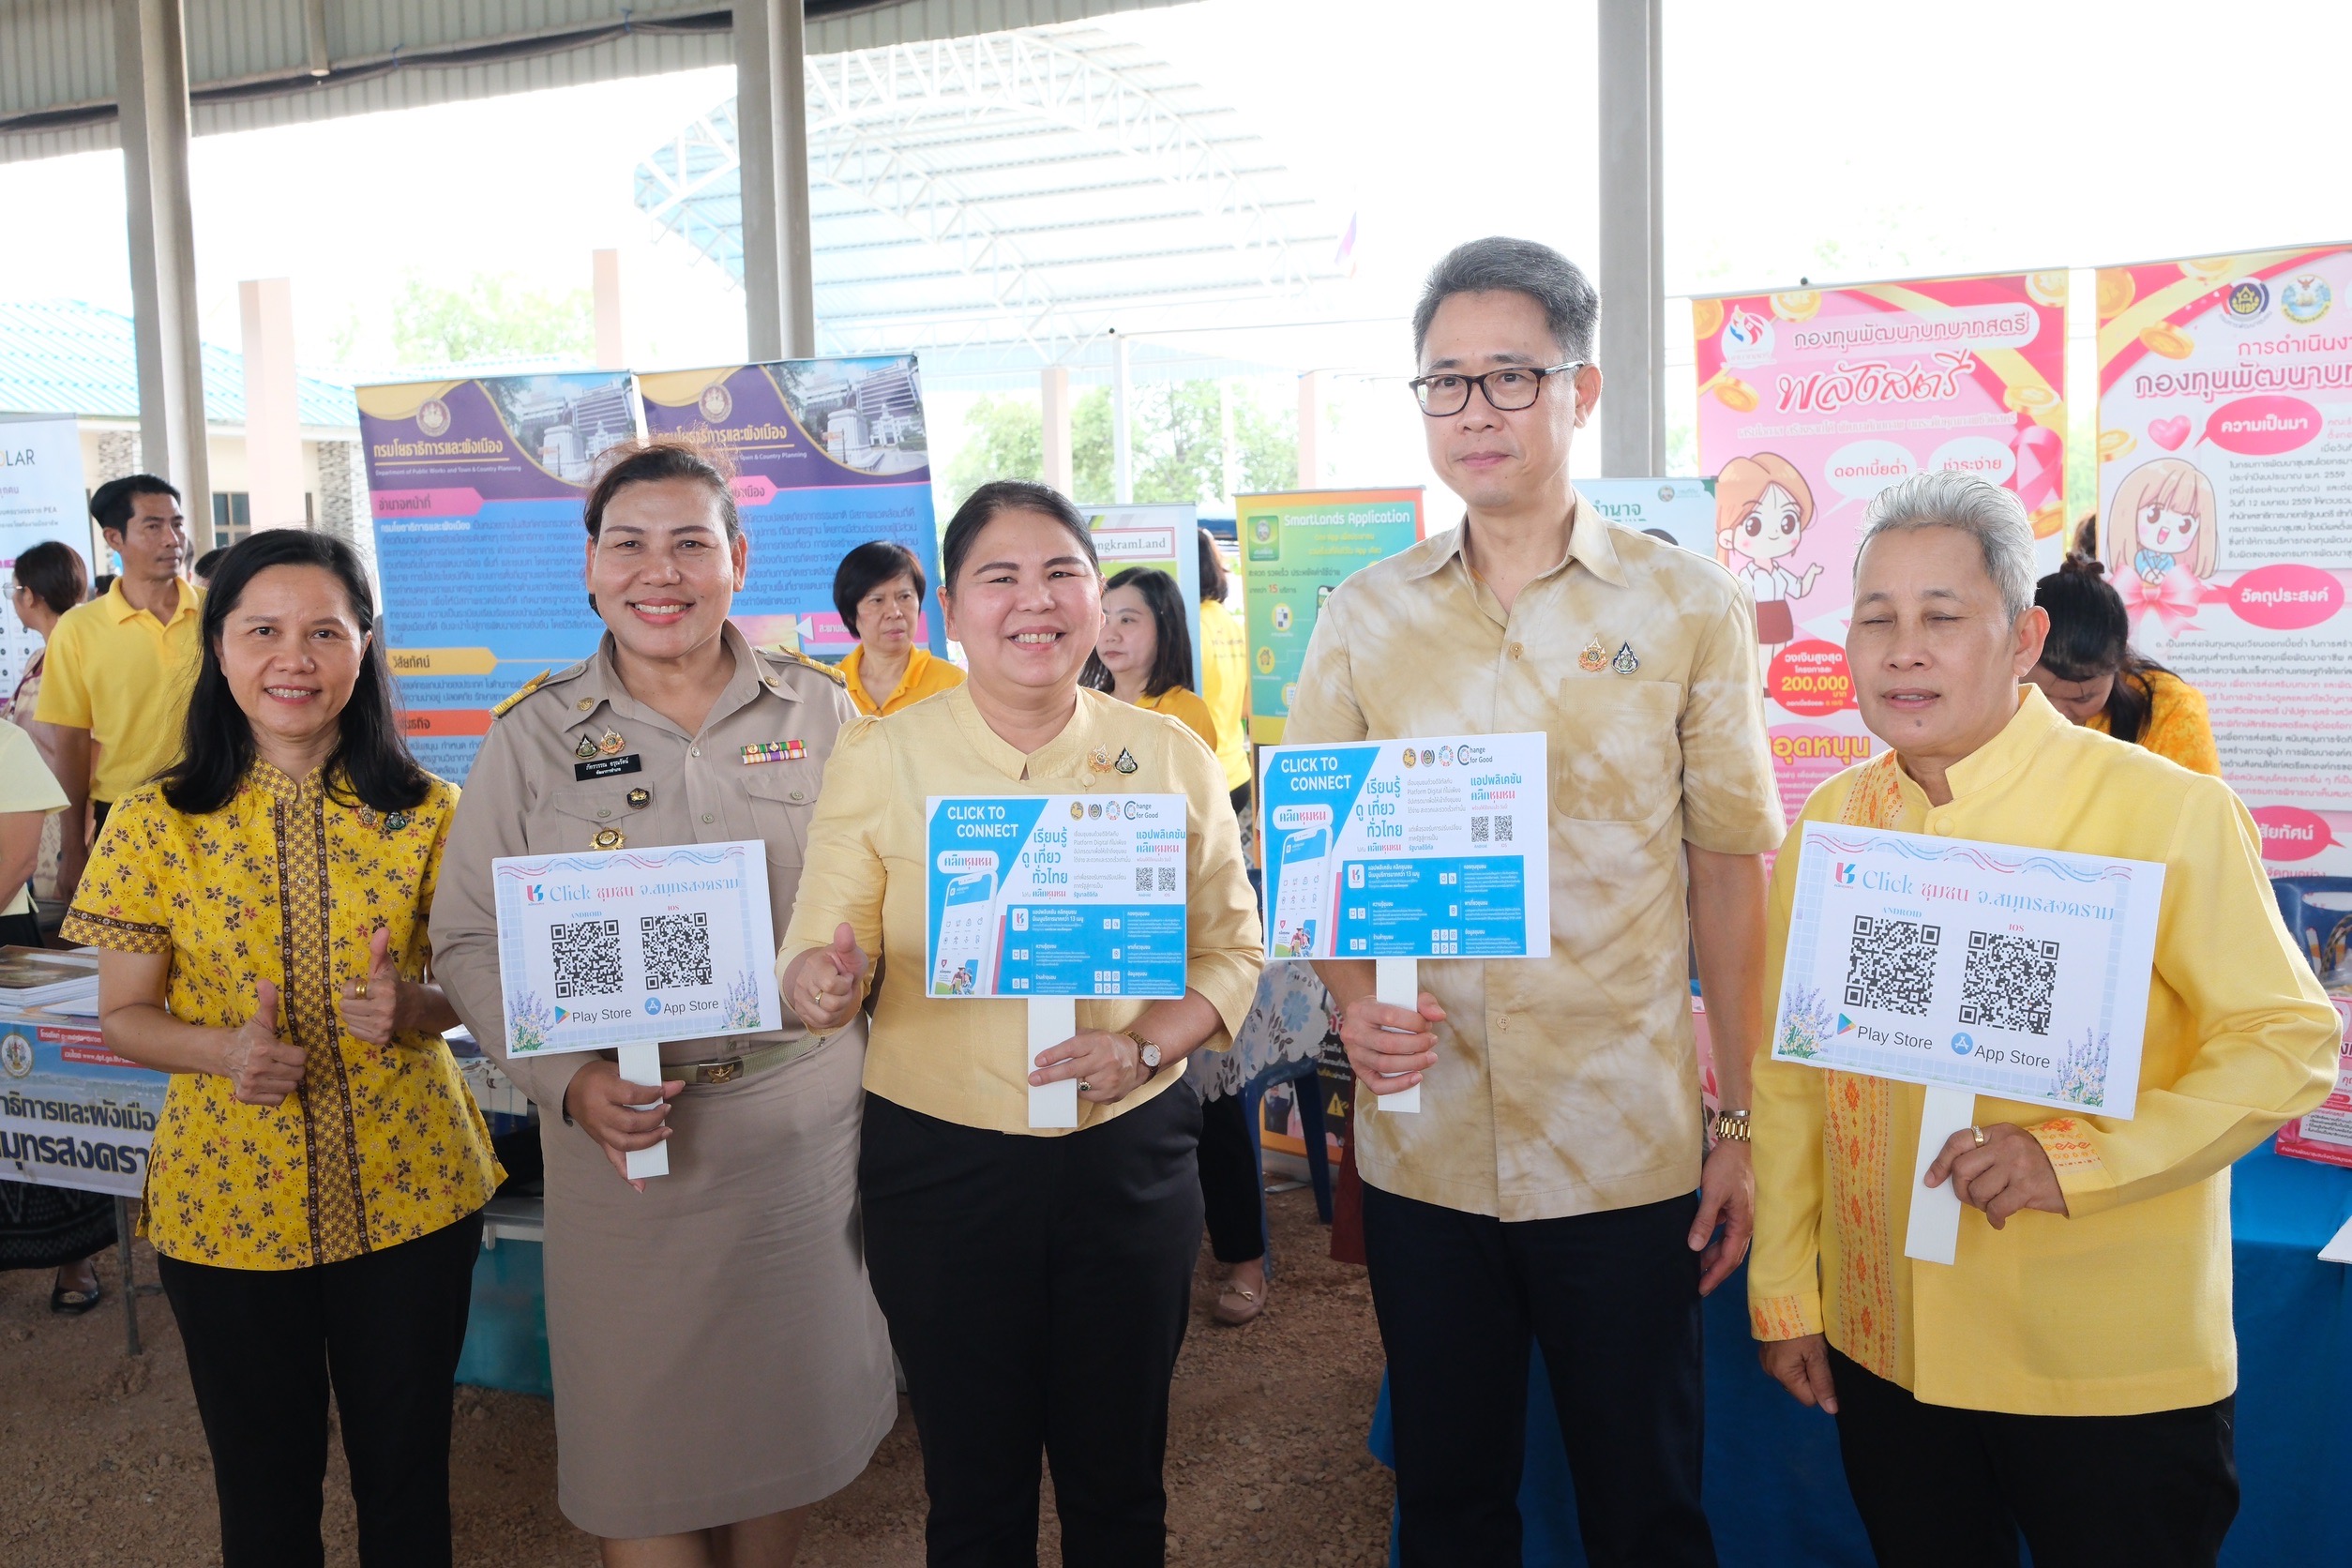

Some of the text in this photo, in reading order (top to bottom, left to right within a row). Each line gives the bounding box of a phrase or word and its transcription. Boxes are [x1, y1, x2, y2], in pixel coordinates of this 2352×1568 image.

[1794, 312, 2030, 352] กองทุนพัฒนาบทบาทสตรี
[1780, 349, 1972, 413] พลังสตรี
[2222, 415, 2308, 432] ความเป็นมา
[373, 437, 504, 459] กรมโยธาธิการและผังเมือง
[782, 450, 807, 460] Planning
[476, 465, 497, 474] Country
[497, 464, 521, 473] Planning
[1834, 458, 1907, 478] ดอกเบี้ยต่ำ
[1944, 457, 2002, 473] ชำระง่าย
[379, 494, 431, 511] อำนาจหน้าที่
[1284, 508, 1410, 527] SmartLands Application
[1269, 583, 1278, 593] 15
[2241, 587, 2329, 608] วัตถุประสงค์
[393, 655, 430, 669] วิสัยทัศน์
[1785, 652, 1843, 665] วงเงินสูงสุด
[1782, 675, 1848, 693] 200,000
[1769, 736, 1870, 765] อุดหนุน
[1281, 757, 1338, 773] CLICK TO
[1290, 775, 1351, 792] CONNECT
[1366, 776, 1401, 798] เรียนรู้
[1470, 772, 1522, 786] แอปพลิเคชัน
[1471, 789, 1515, 804] คลิกชุมชน
[947, 806, 1005, 820] CLICK TO
[1279, 809, 1326, 825] คลิกชุมชน
[1356, 796, 1395, 822] ดู เที่ยว
[957, 824, 1018, 837] CONNECT
[1033, 827, 1067, 848] เรียนรู้
[1136, 828, 1186, 839] แอปพลิเคชัน
[1367, 820, 1403, 838] ทั่วไทย
[1021, 843, 1062, 868] ดู เที่ยว
[1137, 842, 1179, 855] คลิกชุมชน
[1367, 842, 1402, 854] คลิกชุมชน
[944, 854, 992, 870] คลิกชุมชน
[1033, 865, 1068, 884] ทั่วไทย
[550, 878, 740, 903] Click ชุมชน จ.สมุทรสงคราม
[1033, 889, 1066, 900] คลิกชุมชน
[1862, 869, 2115, 922] Click ชุมชน จ.สมุทรสงคราม
[570, 911, 603, 919] ANDROID
[1882, 907, 1922, 918] ANDROID
[2008, 923, 2025, 933] IOS
[572, 1006, 632, 1023] Play Store
[663, 998, 719, 1015] App Store
[1857, 1025, 1934, 1050] Play Store
[1974, 1044, 2051, 1070] App Store
[0, 1131, 149, 1174] มุทรสงครา
